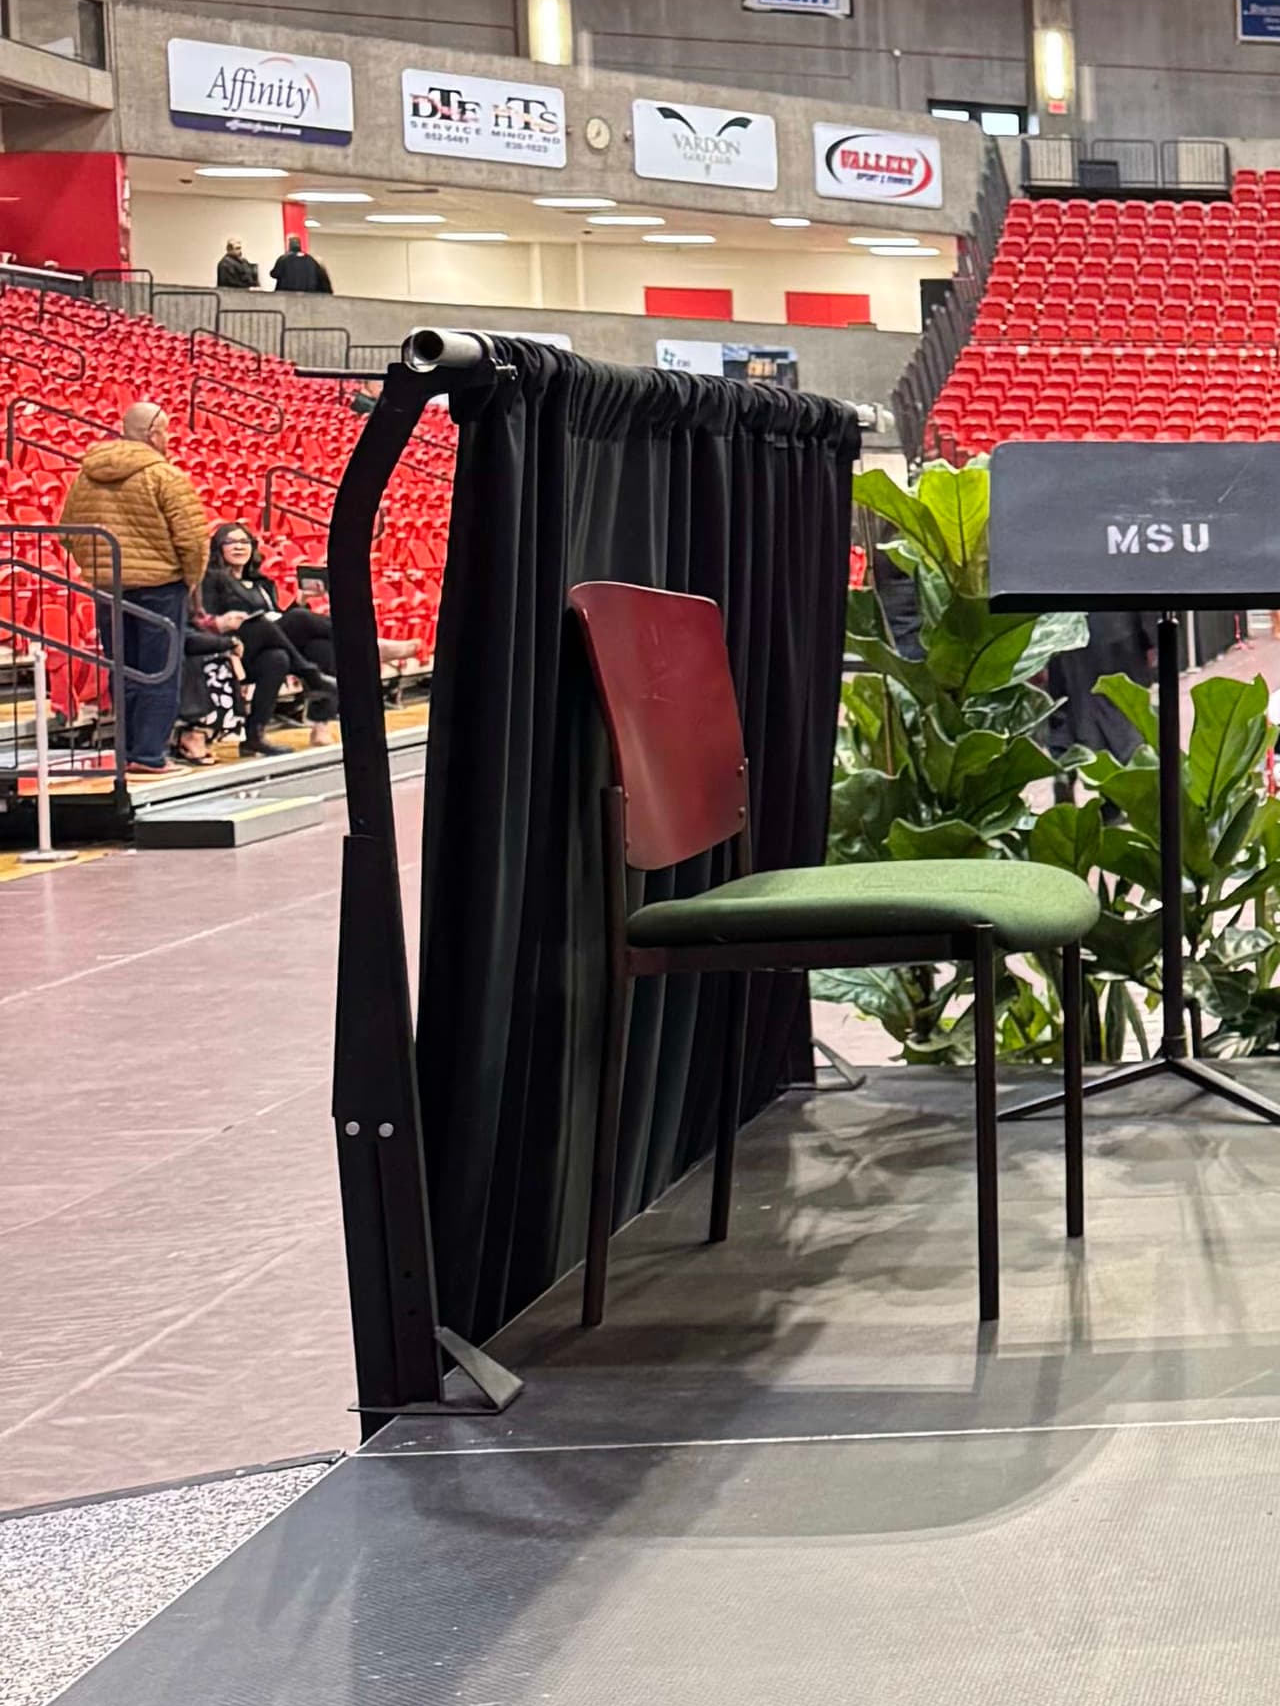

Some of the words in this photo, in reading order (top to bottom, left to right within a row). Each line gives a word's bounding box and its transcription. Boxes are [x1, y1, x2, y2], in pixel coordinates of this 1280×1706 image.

[206, 66, 311, 119] Affinity
[410, 120, 482, 136] SERVICE
[673, 133, 740, 155] VARDON
[1107, 523, 1210, 554] MSU
